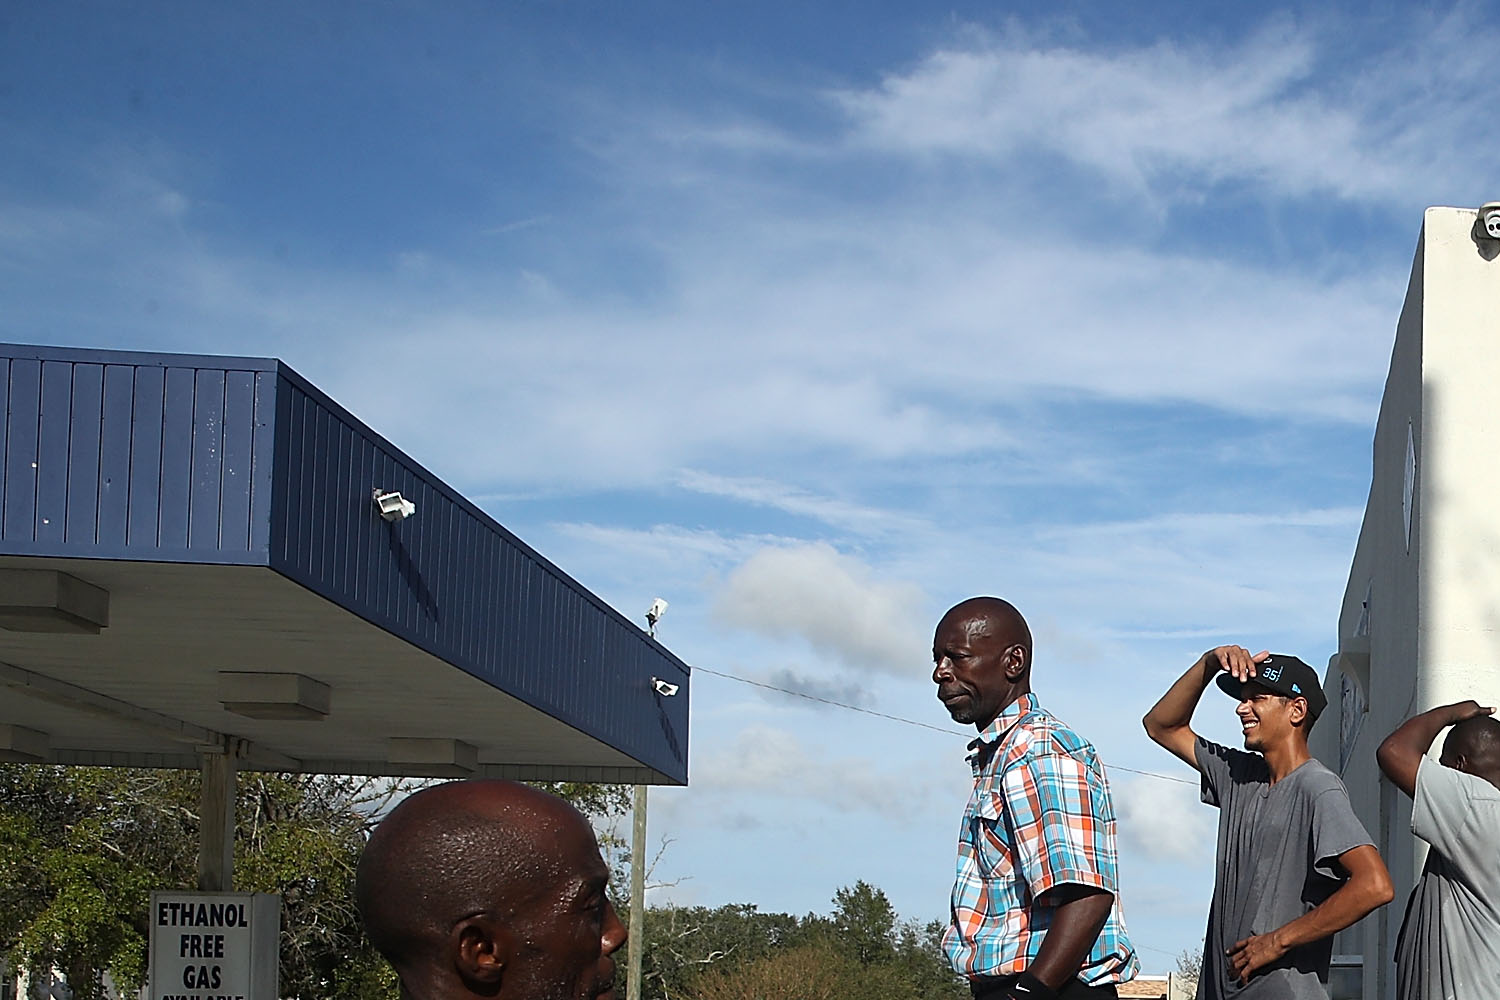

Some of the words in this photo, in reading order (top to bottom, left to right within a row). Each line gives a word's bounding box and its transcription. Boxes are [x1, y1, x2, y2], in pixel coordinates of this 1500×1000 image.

[158, 902, 248, 928] ETHANOL
[180, 934, 225, 958] FREE
[183, 965, 222, 989] GAS
